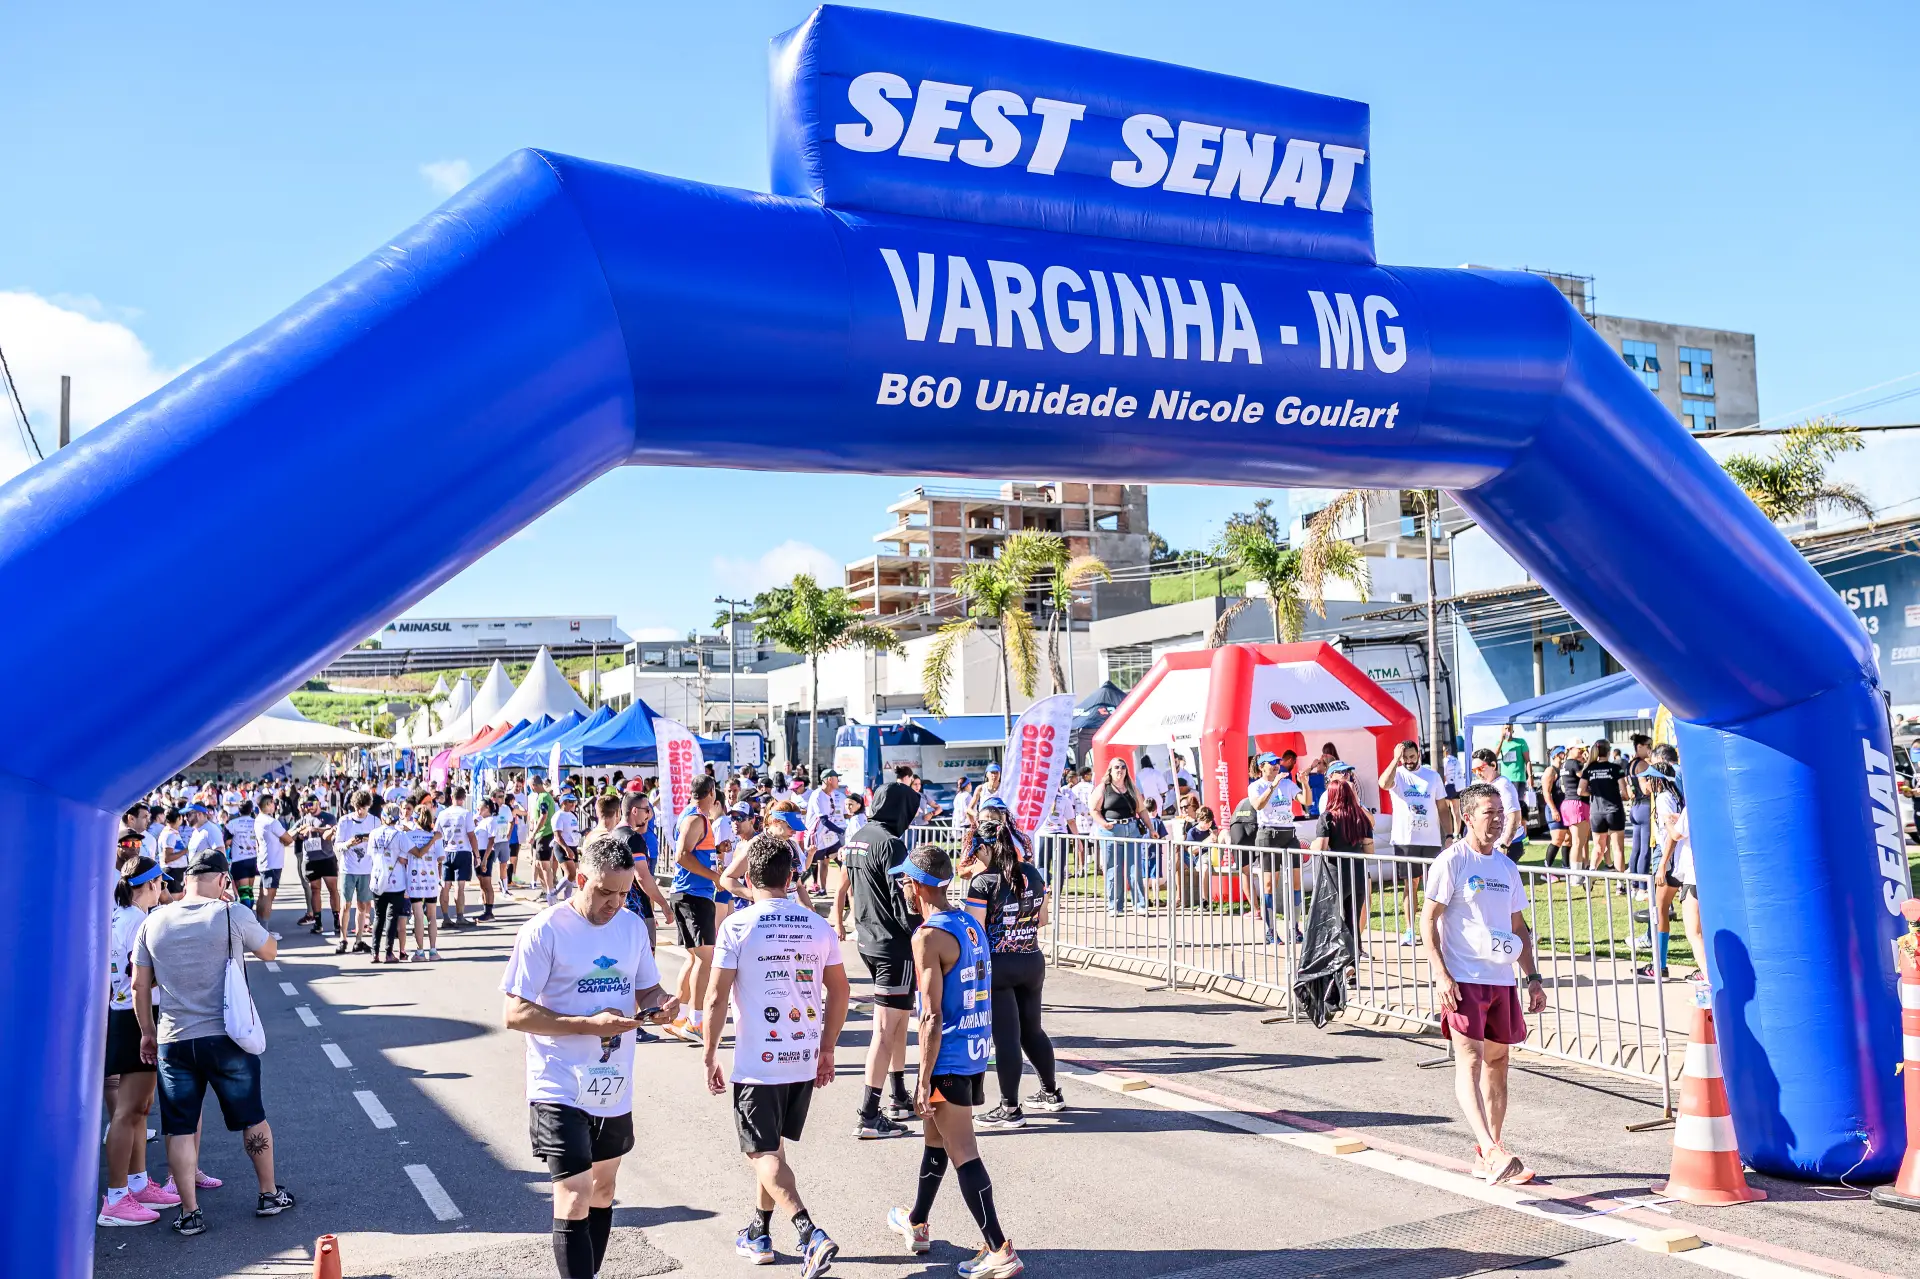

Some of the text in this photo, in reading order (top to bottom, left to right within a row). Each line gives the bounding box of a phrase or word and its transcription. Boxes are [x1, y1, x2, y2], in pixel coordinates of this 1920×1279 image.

[835, 71, 1365, 213] SEST SENAT
[879, 248, 1263, 365] VARGINHA
[1307, 290, 1407, 374] MG
[876, 372, 1399, 429] B60 Unidade Nicole Goulart
[398, 622, 452, 632] MINASUL
[1368, 667, 1401, 679] ATMA
[1290, 701, 1350, 715] ONCOMINAS
[944, 759, 966, 768] SEST
[1027, 724, 1055, 831] EVENTOS
[1862, 738, 1909, 917] SENAT
[760, 914, 782, 922] SEST
[765, 970, 790, 979] ATMA
[578, 977, 621, 987] CORRIDA
[586, 1076, 625, 1096] 427
